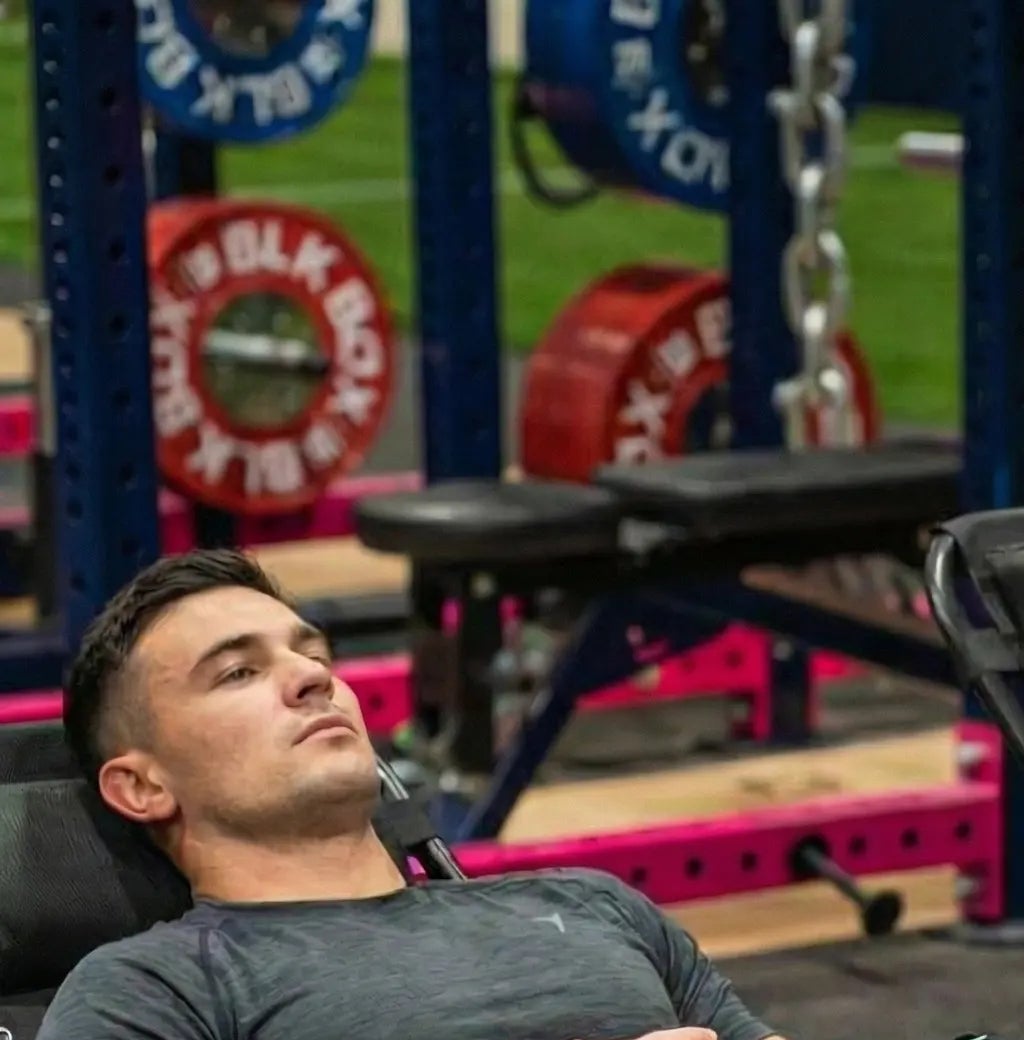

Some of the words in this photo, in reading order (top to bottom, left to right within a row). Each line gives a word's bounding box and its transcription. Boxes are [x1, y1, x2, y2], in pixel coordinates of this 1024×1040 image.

[136, 0, 198, 90] BO
[190, 64, 312, 125] BLK
[221, 219, 338, 292] BLK
[325, 279, 384, 425] BOX
[186, 421, 304, 494] BLK
